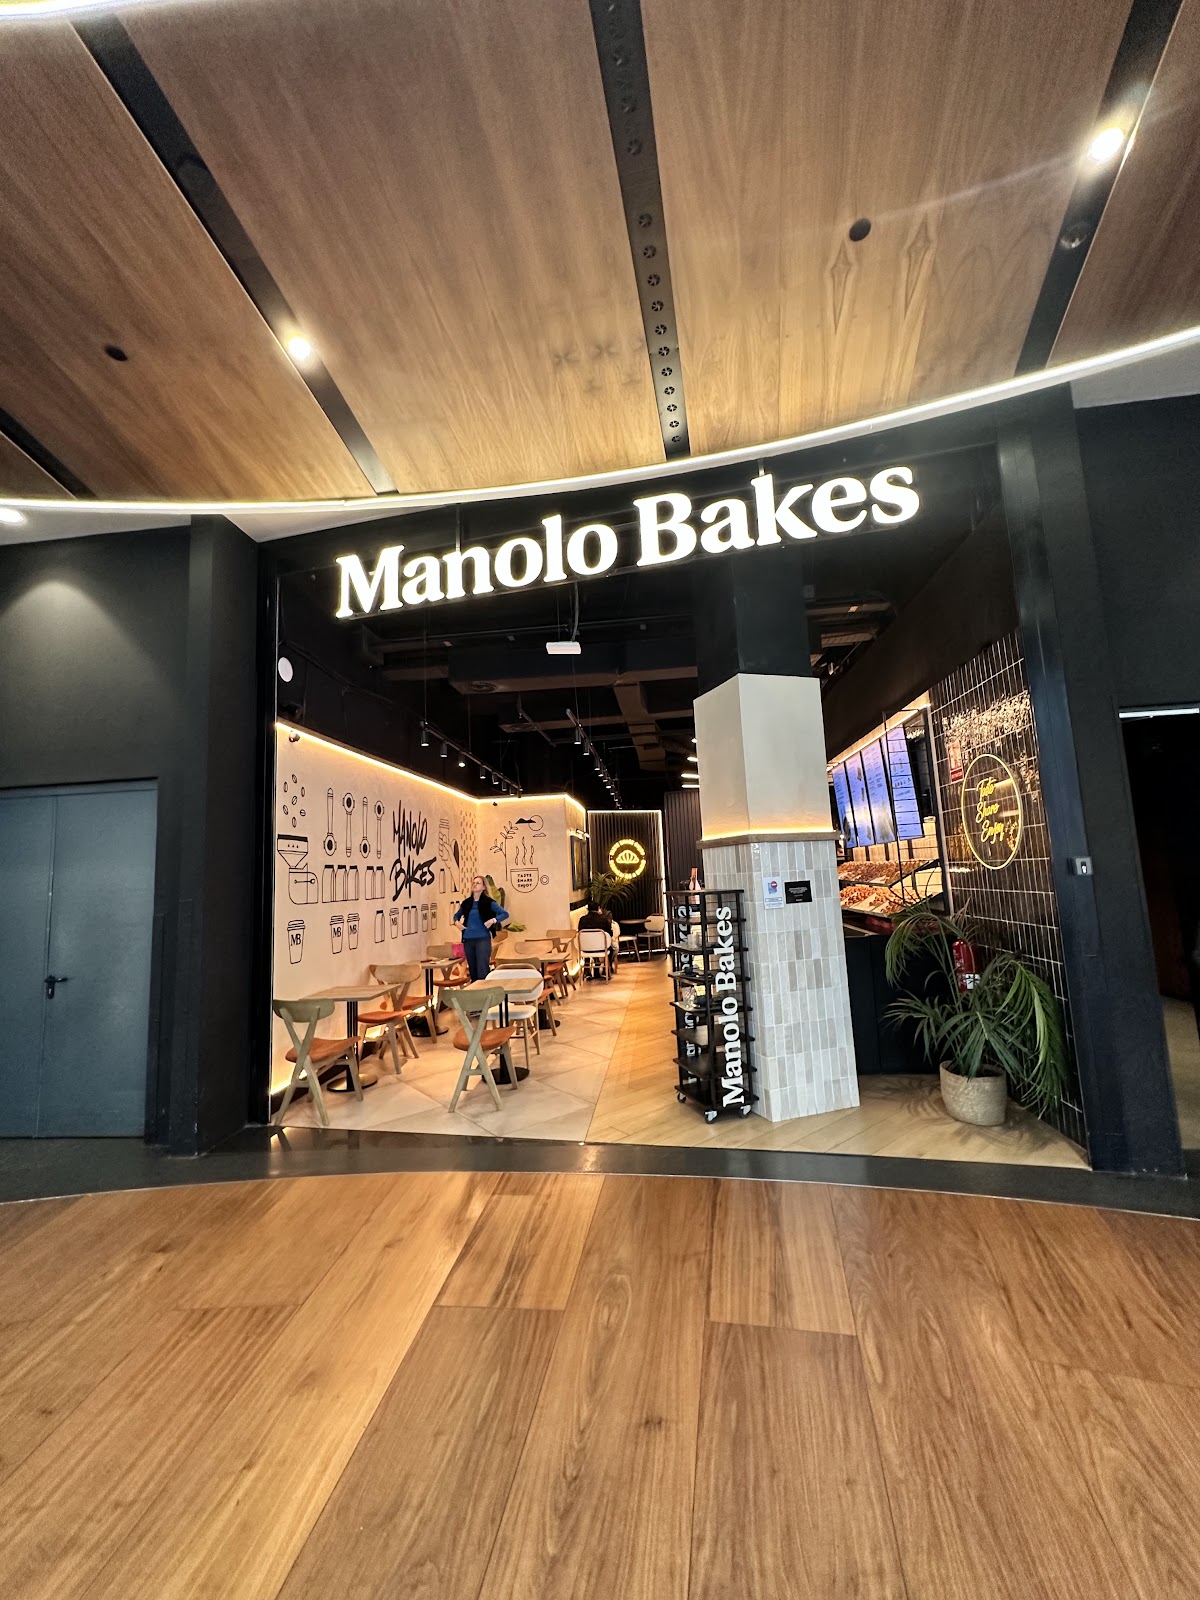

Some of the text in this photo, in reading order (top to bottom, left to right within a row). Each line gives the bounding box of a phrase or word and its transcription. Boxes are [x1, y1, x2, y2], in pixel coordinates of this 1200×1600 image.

[334, 465, 920, 619] Manolo Bakes
[976, 777, 997, 801] Taste
[975, 801, 1000, 823] Share
[981, 820, 1005, 844] Enjoy
[390, 855, 437, 901] BAKES
[290, 933, 302, 946] MB
[333, 927, 342, 938] MB
[349, 924, 358, 935] MB
[715, 906, 745, 1108] Manolo Bakes
